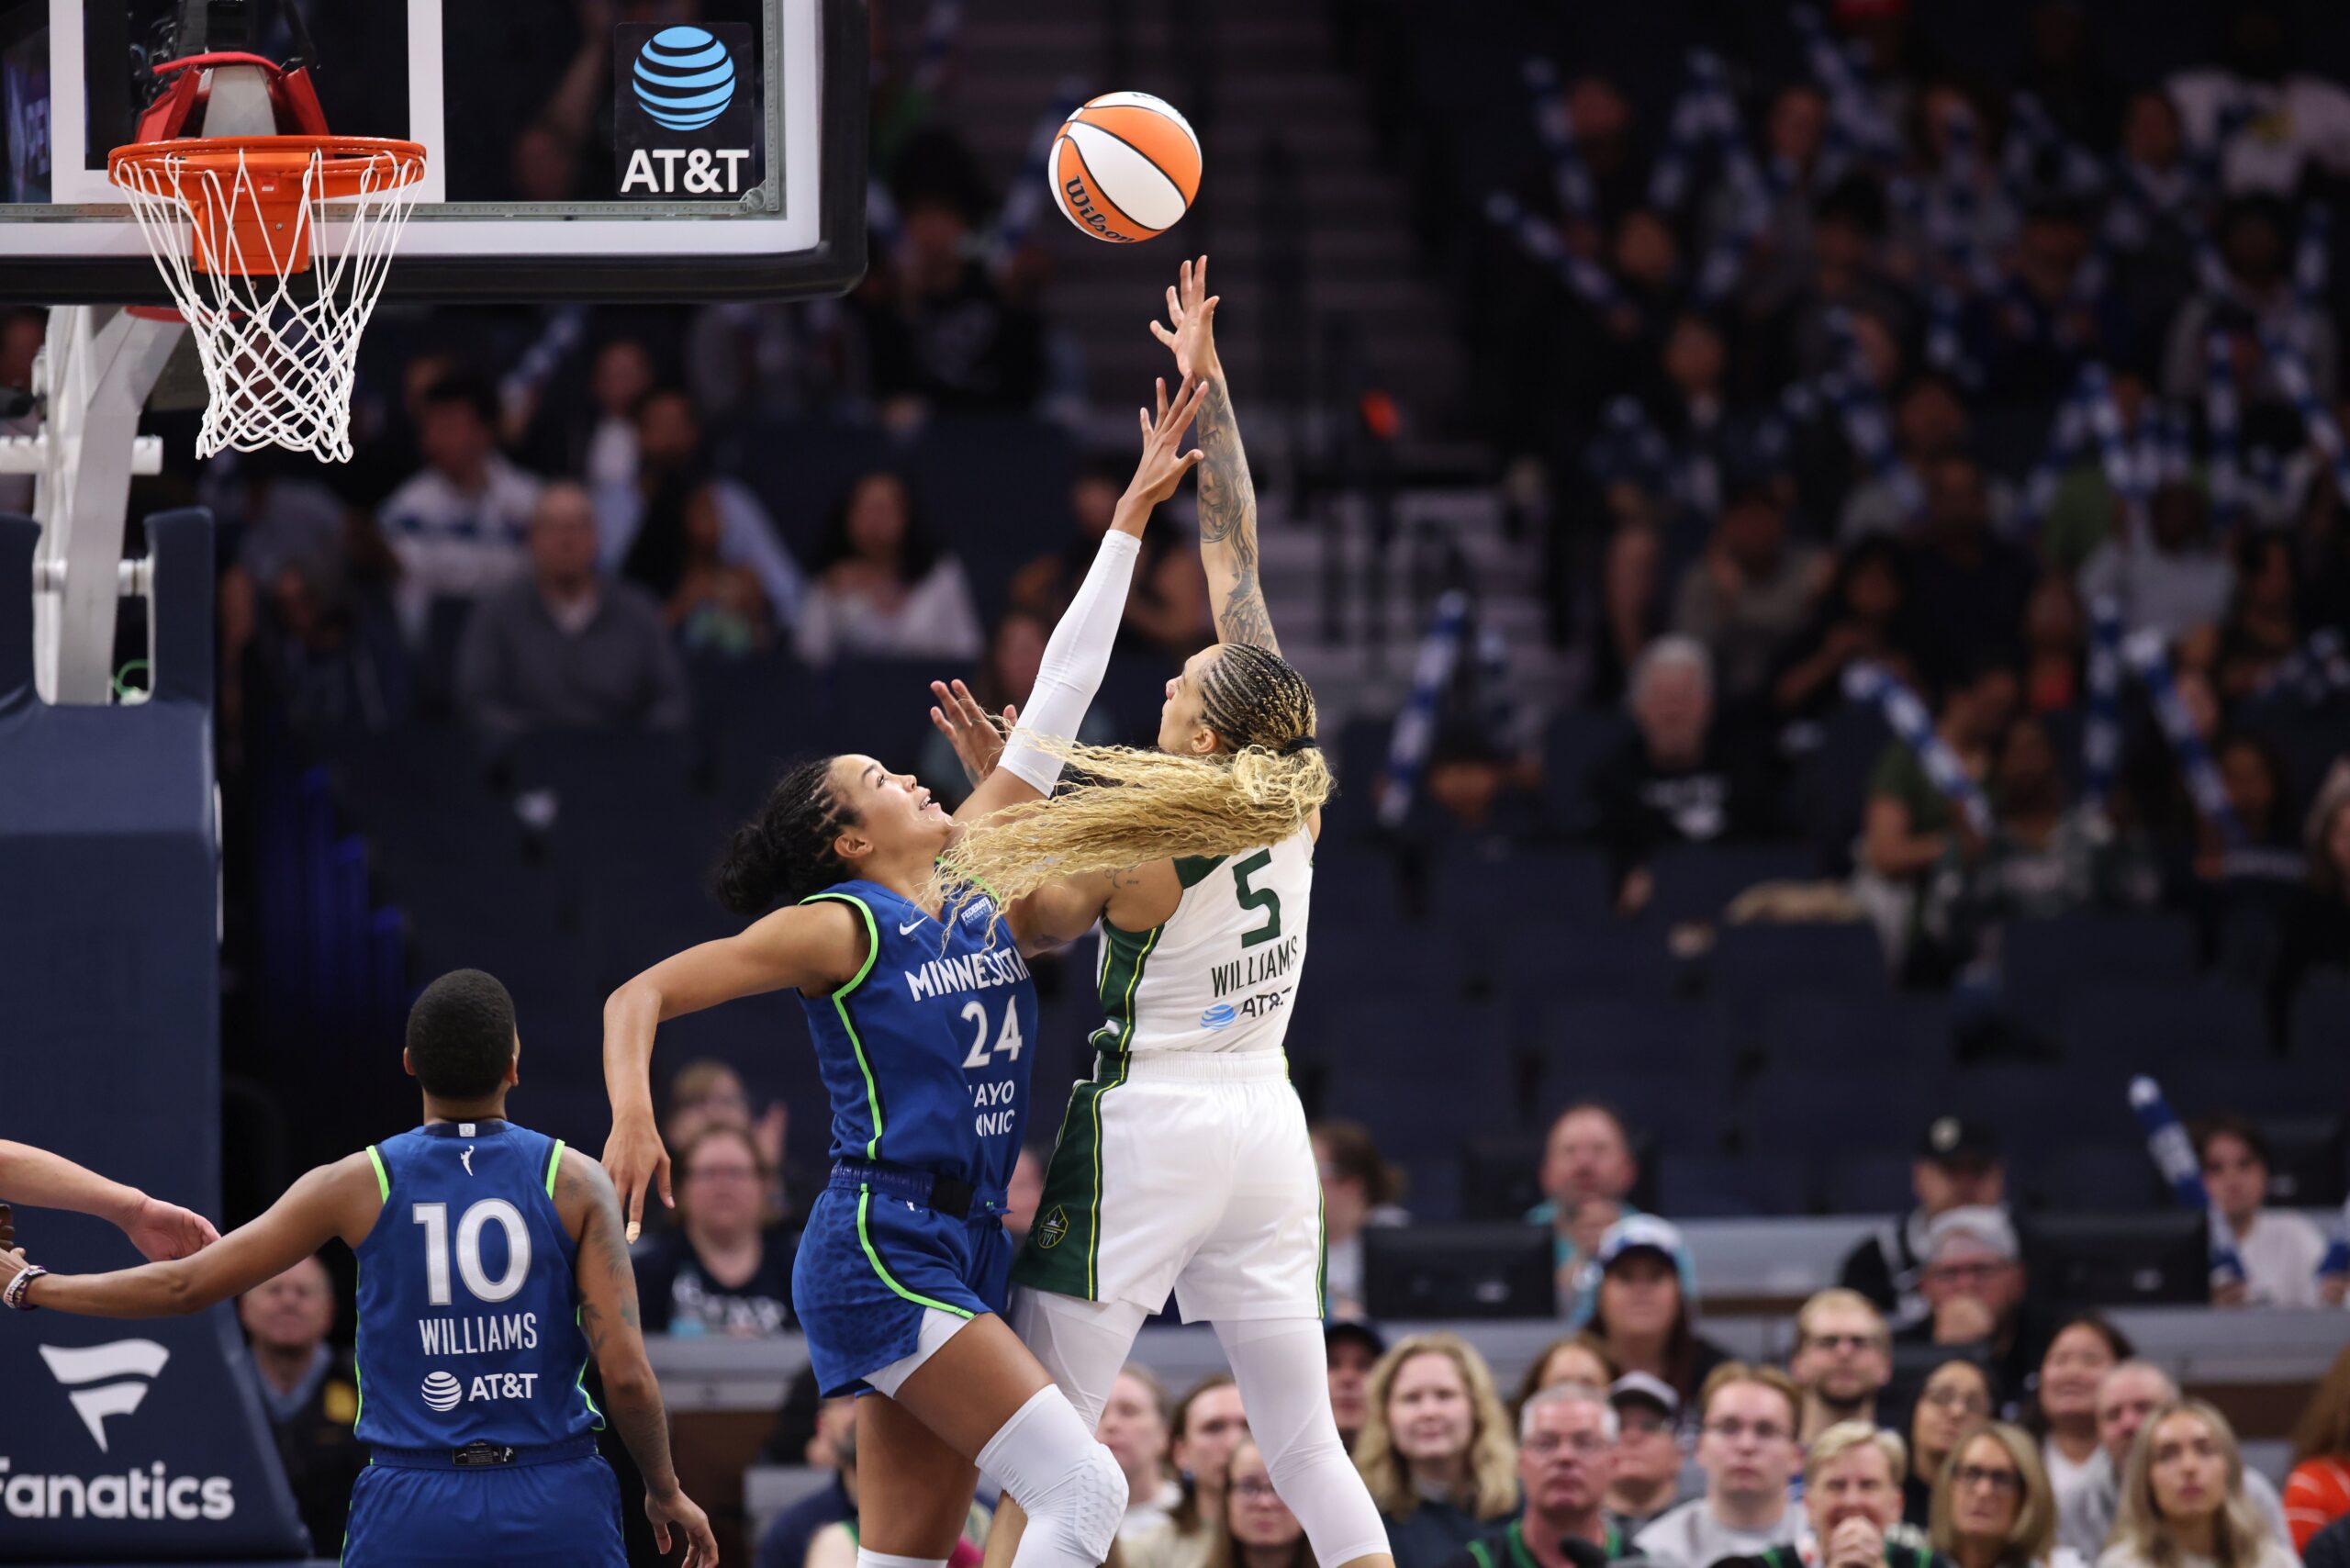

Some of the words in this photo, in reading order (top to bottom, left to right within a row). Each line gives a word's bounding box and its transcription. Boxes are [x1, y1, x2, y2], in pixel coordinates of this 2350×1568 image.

[620, 149, 749, 193] AT&T
[1065, 174, 1136, 242] Wilson
[1232, 847, 1281, 949] 5
[904, 945, 1030, 1002] MINNESOTA
[1212, 935, 1297, 998] WILLIAMS
[960, 994, 1023, 1069] 24
[968, 1080, 1015, 1108] AYO
[412, 1197, 532, 1306] 10
[419, 1312, 538, 1355] WILLIAMS
[468, 1373, 538, 1402] AT&T
